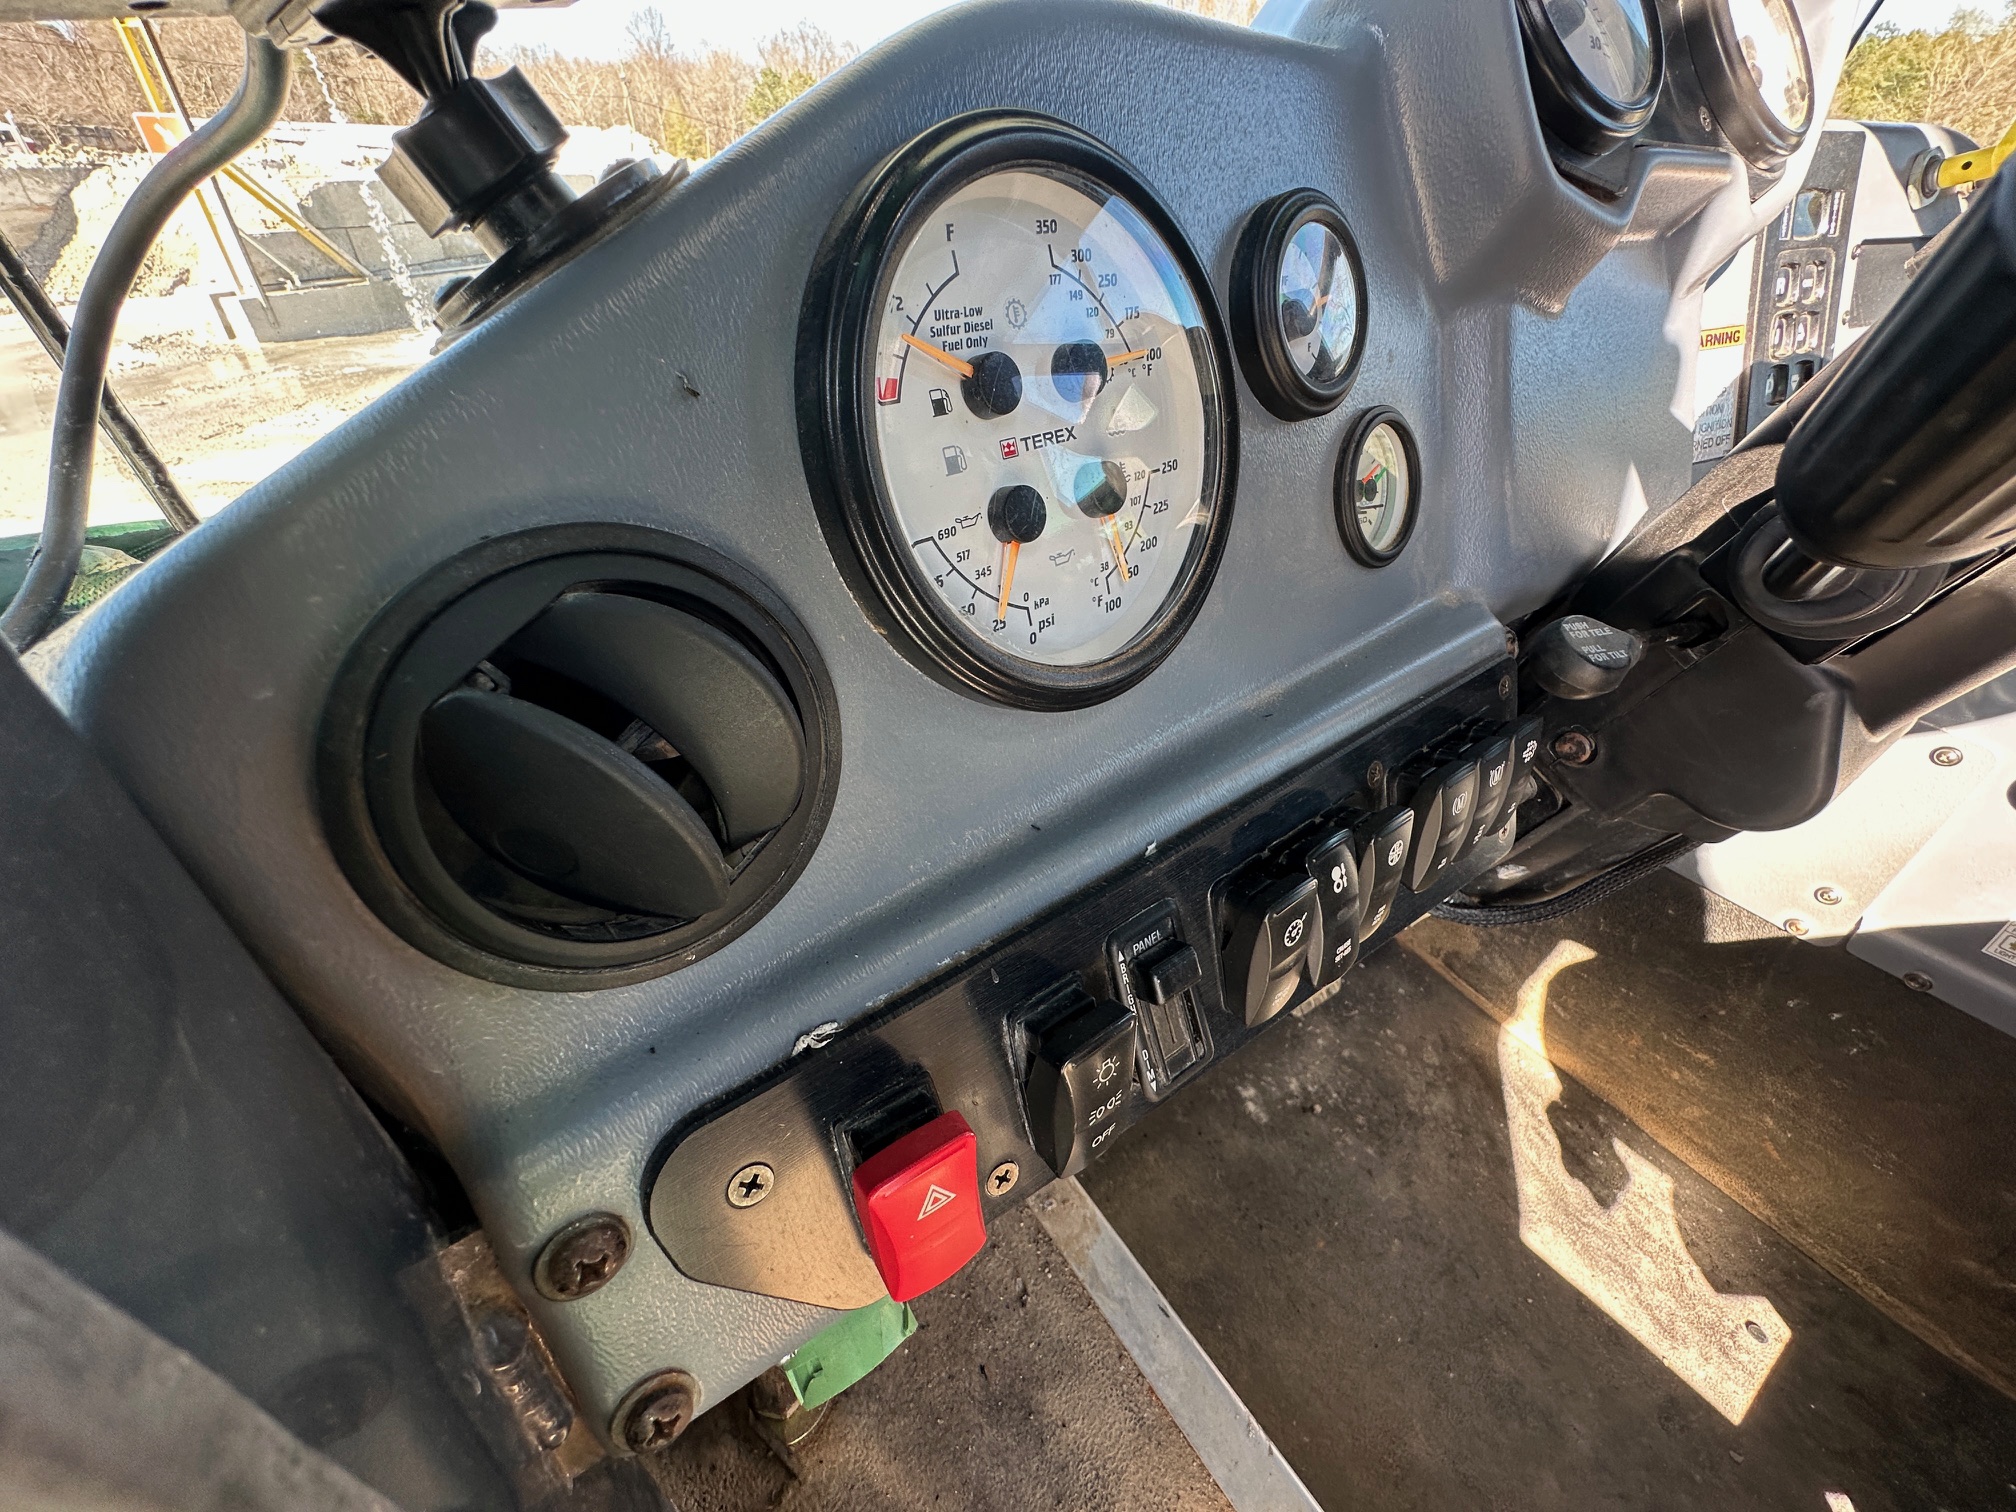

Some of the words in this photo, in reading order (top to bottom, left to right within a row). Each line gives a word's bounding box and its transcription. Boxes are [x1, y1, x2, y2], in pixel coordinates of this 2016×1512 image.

[1589, 36, 1601, 50] 30
[946, 224, 954, 242] F
[1036, 219, 1057, 234] 350
[1071, 248, 1092, 263] 300
[1049, 273, 1062, 285] 177
[1098, 273, 1117, 288] 250
[1069, 289, 1083, 301] 149
[934, 306, 983, 322] Ultra-Low
[1086, 306, 1099, 318] 120
[1124, 306, 1140, 321] 175
[930, 325, 961, 339] Sulfur
[964, 319, 993, 334] Diesel
[1105, 328, 1115, 339] 79
[942, 338, 963, 352] Fuel
[966, 336, 988, 352] Only
[1700, 330, 1741, 348] ARNING
[1020, 425, 1077, 452] TEREX
[1161, 459, 1178, 475] 250
[1134, 469, 1146, 481] 120
[1130, 495, 1141, 506] 107
[1153, 499, 1169, 515] 225
[937, 525, 957, 541] 690
[1124, 520, 1134, 531] 93
[1140, 535, 1158, 552] 200
[956, 548, 971, 563] 517
[975, 565, 992, 580] 345
[1100, 561, 1109, 572] 38
[1127, 564, 1139, 579] 50
[1023, 592, 1030, 602] 0
[1034, 597, 1050, 610] kPa
[1105, 596, 1122, 613] 100
[993, 618, 1007, 632] 25
[1038, 613, 1055, 633] psi
[1562, 621, 1590, 632] PUSH
[1029, 631, 1037, 644] 0
[1569, 629, 1590, 640] FOR
[1588, 626, 1614, 638] TELE
[1581, 644, 1607, 655] PULL
[1588, 653, 1610, 663] FOR
[1607, 649, 1629, 661] TILT
[1132, 929, 1164, 956] PANEL
[1119, 962, 1138, 1015] BRIGH
[1141, 1049, 1156, 1082] DIM
[1091, 1122, 1117, 1149] OFF
